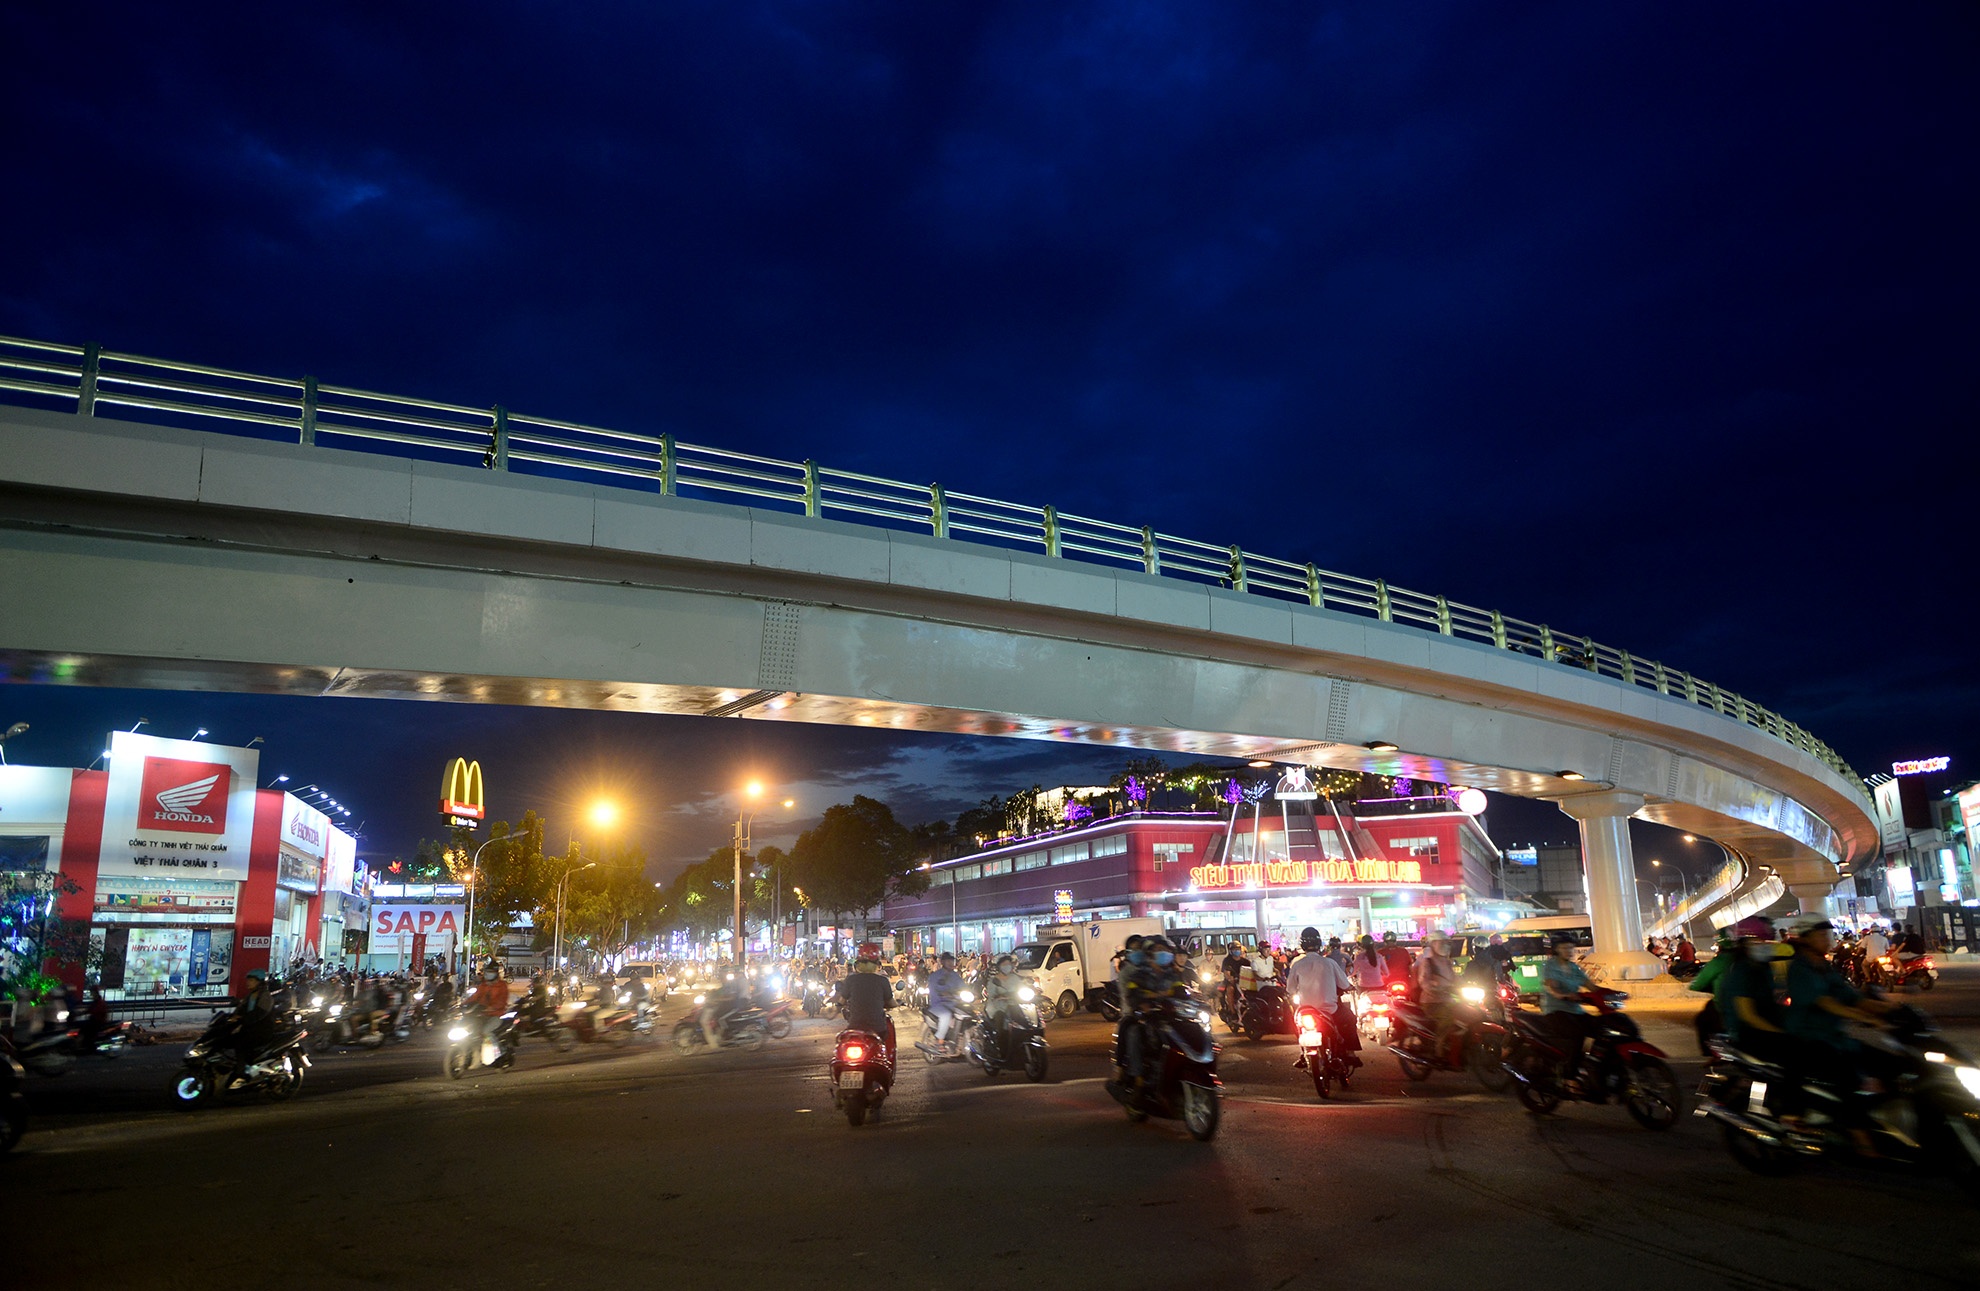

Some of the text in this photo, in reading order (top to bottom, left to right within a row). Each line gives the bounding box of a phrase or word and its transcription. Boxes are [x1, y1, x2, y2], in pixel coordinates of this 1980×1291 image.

[154, 811, 214, 824] HONDA
[297, 822, 320, 847] HONDA
[129, 838, 147, 848] CÔNG
[161, 841, 177, 849] TNHH
[179, 841, 192, 850] VIỆT
[211, 844, 227, 852] QUÂN
[133, 855, 155, 867] VIỆT
[158, 857, 179, 867] THÁI
[183, 858, 207, 868] QUÂN
[1190, 864, 1228, 887] SIÊU
[1231, 864, 1264, 887] THỊ
[1266, 860, 1308, 883] VĂN
[1311, 858, 1352, 882] HÓA
[1354, 858, 1388, 882] VĂN
[376, 910, 458, 934] SAPA
